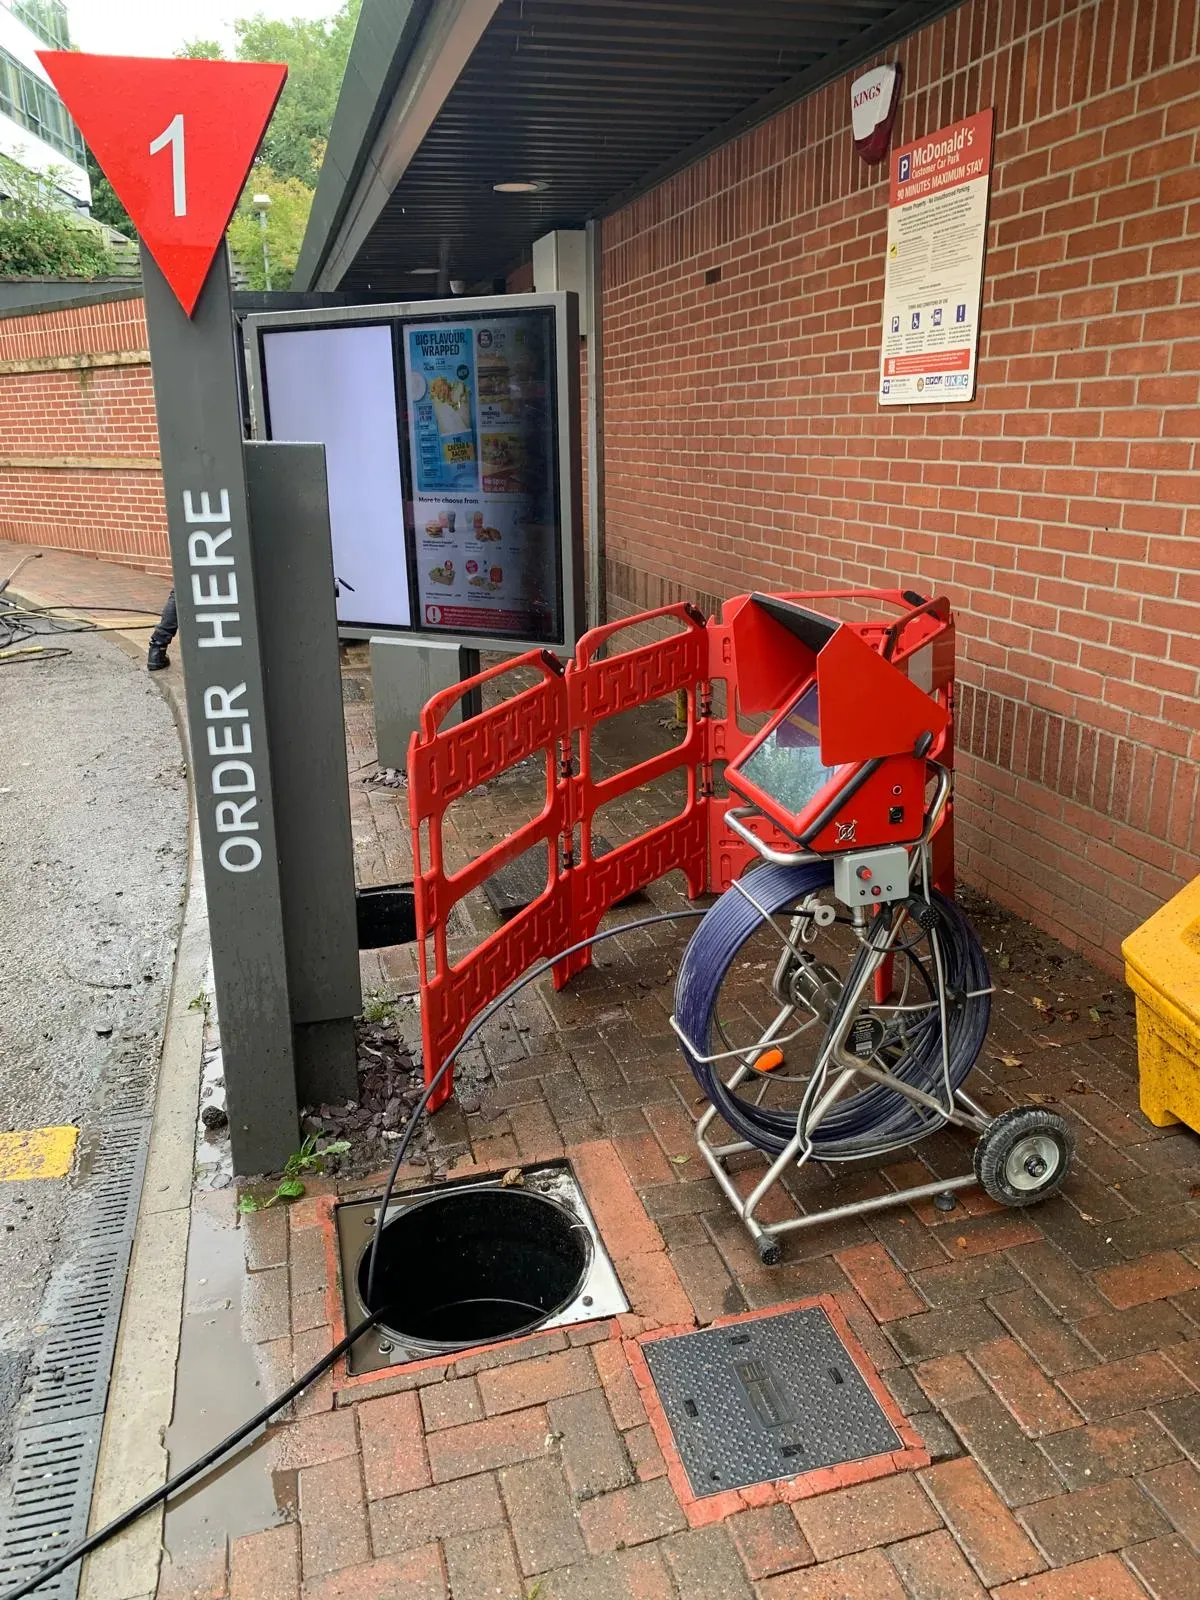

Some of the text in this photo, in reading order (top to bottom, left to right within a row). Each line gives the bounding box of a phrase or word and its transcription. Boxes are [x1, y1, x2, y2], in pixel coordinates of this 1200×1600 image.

[854, 83, 881, 108] KINGS
[912, 128, 974, 168] McDonald's
[150, 114, 187, 217] 1
[912, 154, 960, 180] Customer Car Park
[897, 158, 984, 200] 90 MINUTES MAXIMUM STAY
[416, 334, 430, 346] BIG
[422, 344, 460, 356] WRAPPED
[944, 374, 968, 386] UKPC
[183, 488, 263, 873] ORDER HERE
